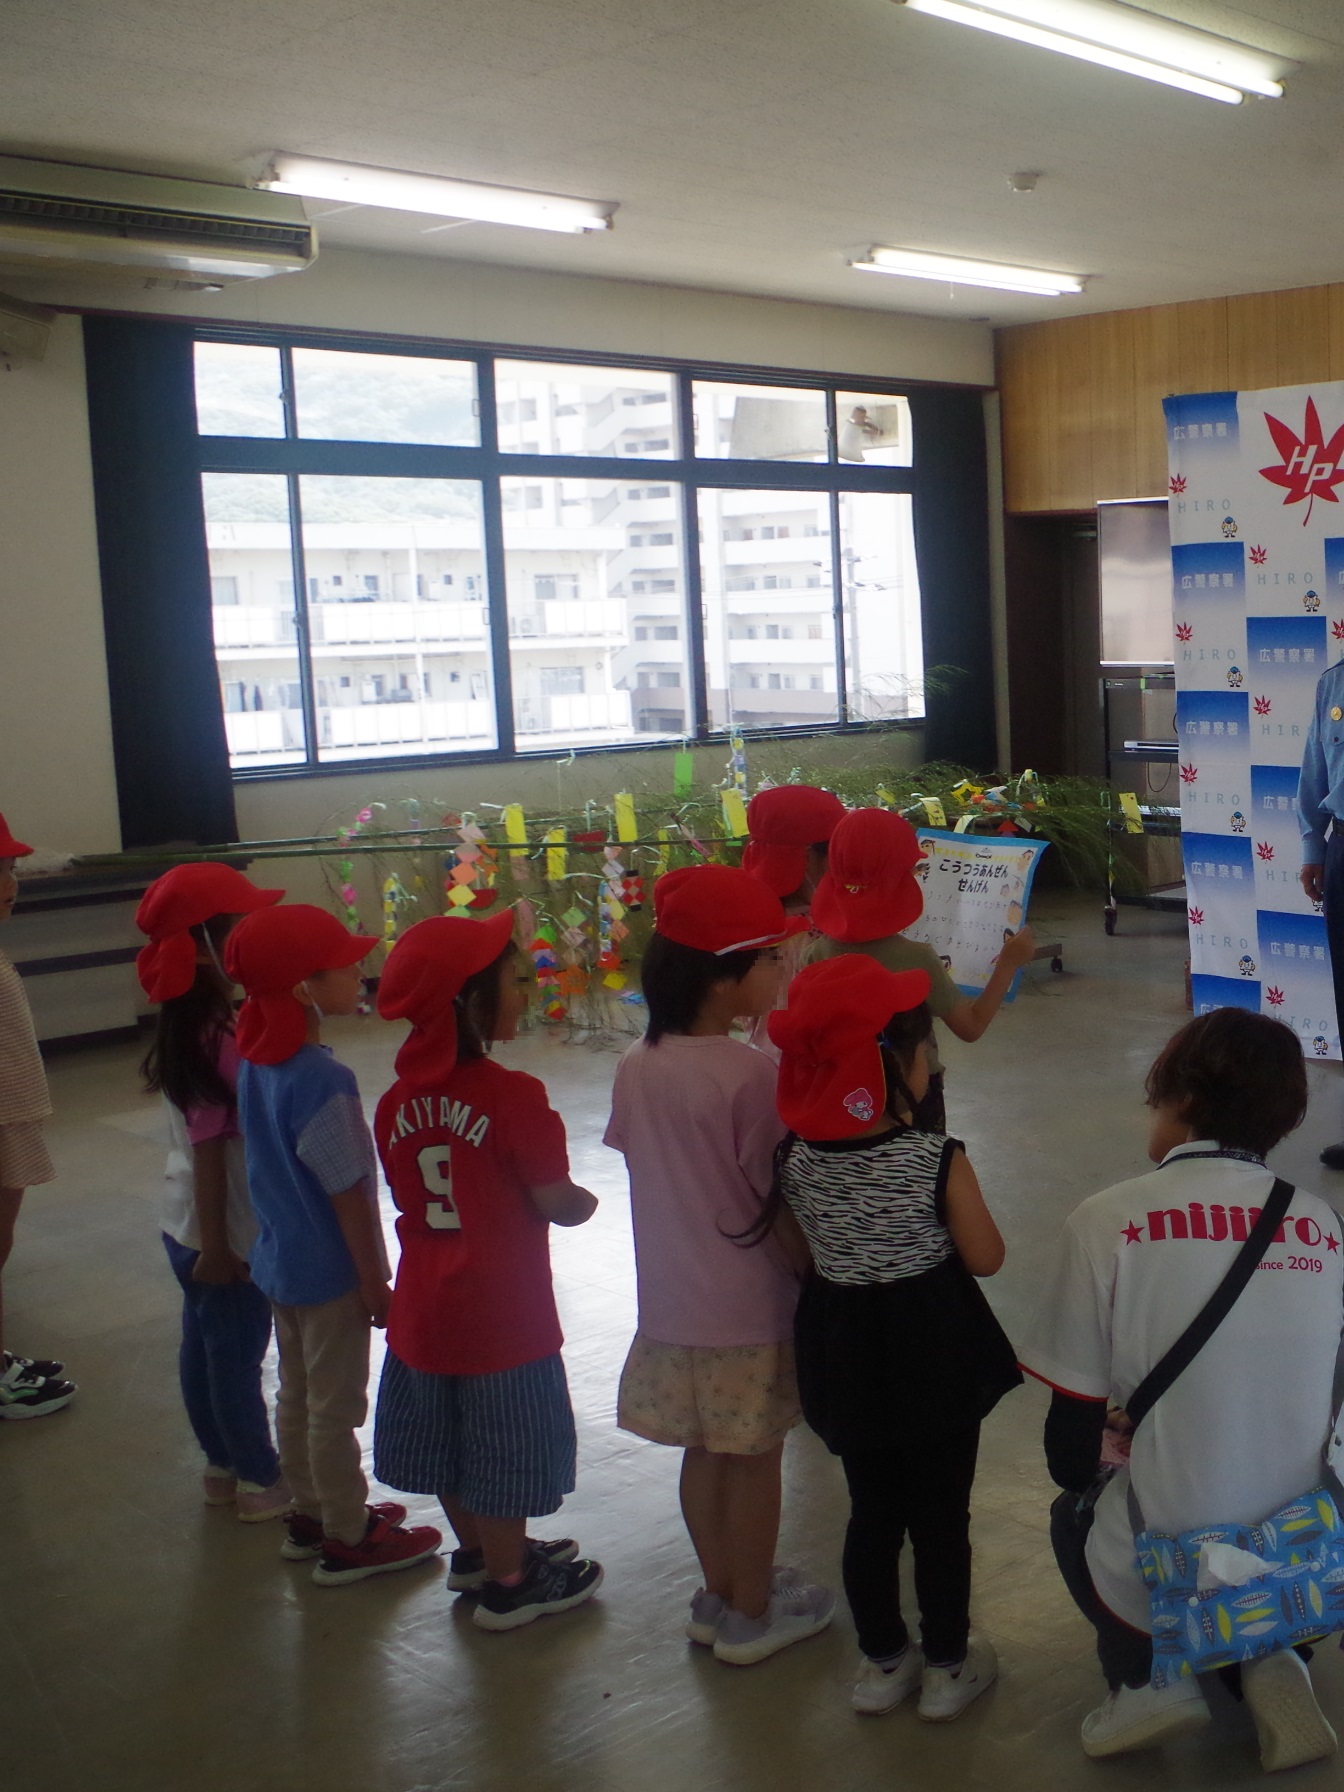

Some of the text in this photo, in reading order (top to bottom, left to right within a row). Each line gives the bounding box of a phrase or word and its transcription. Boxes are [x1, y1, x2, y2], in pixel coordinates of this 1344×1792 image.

[1173, 422, 1227, 440] 広警察署
[1177, 499, 1230, 513] HIRO
[1181, 574, 1234, 588] 広警察署
[1257, 572, 1313, 585] HIRO
[1183, 649, 1236, 661] HIRO
[1259, 648, 1316, 663] 広警察署
[1186, 721, 1238, 735] 広警察署
[1262, 724, 1300, 737] HIR
[1188, 791, 1240, 805] HIRO
[939, 859, 1008, 879] こうつうあんぜん
[1191, 862, 1243, 880] 広警察署
[958, 878, 989, 893] せんげん
[1196, 934, 1248, 949] HIRO
[1270, 942, 1325, 961] 広警察署
[417, 1145, 461, 1229] 9
[1288, 1256, 1323, 1273] 2019
